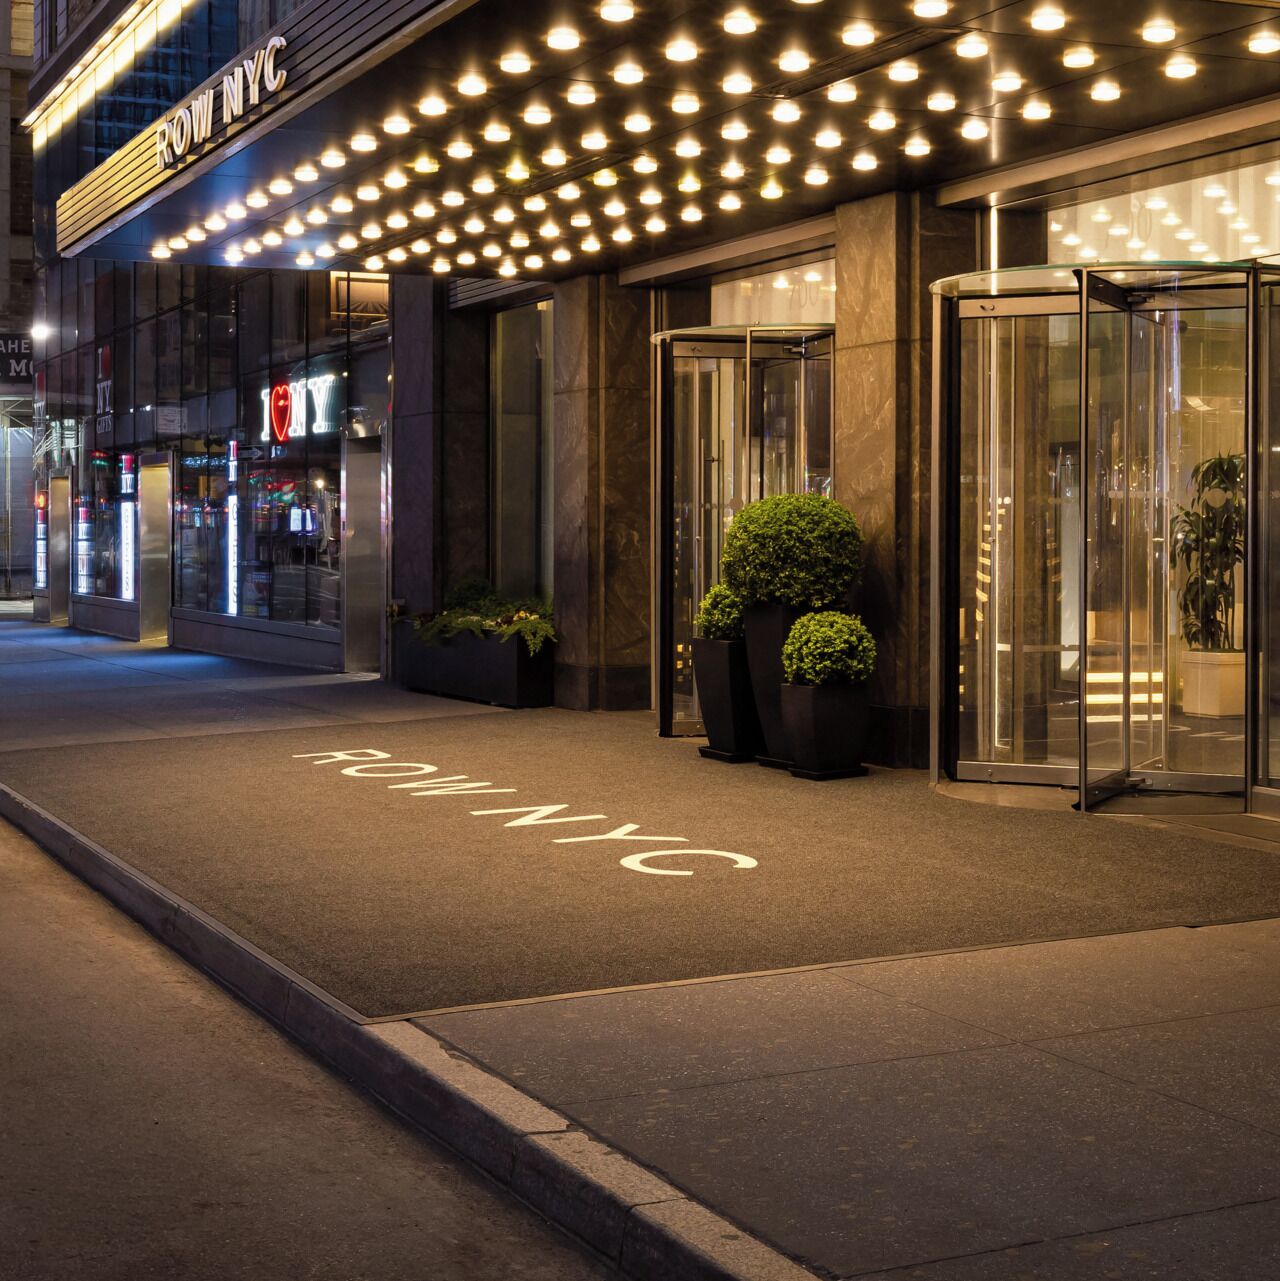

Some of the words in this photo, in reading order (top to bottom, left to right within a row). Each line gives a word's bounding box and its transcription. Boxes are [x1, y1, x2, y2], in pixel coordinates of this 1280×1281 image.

[157, 89, 214, 169] ROW
[223, 36, 287, 123] NYC
[96, 380, 111, 415] NY
[261, 388, 269, 440] I
[289, 374, 335, 436] NY
[291, 748, 518, 796] ROW
[469, 804, 758, 876] NYC
